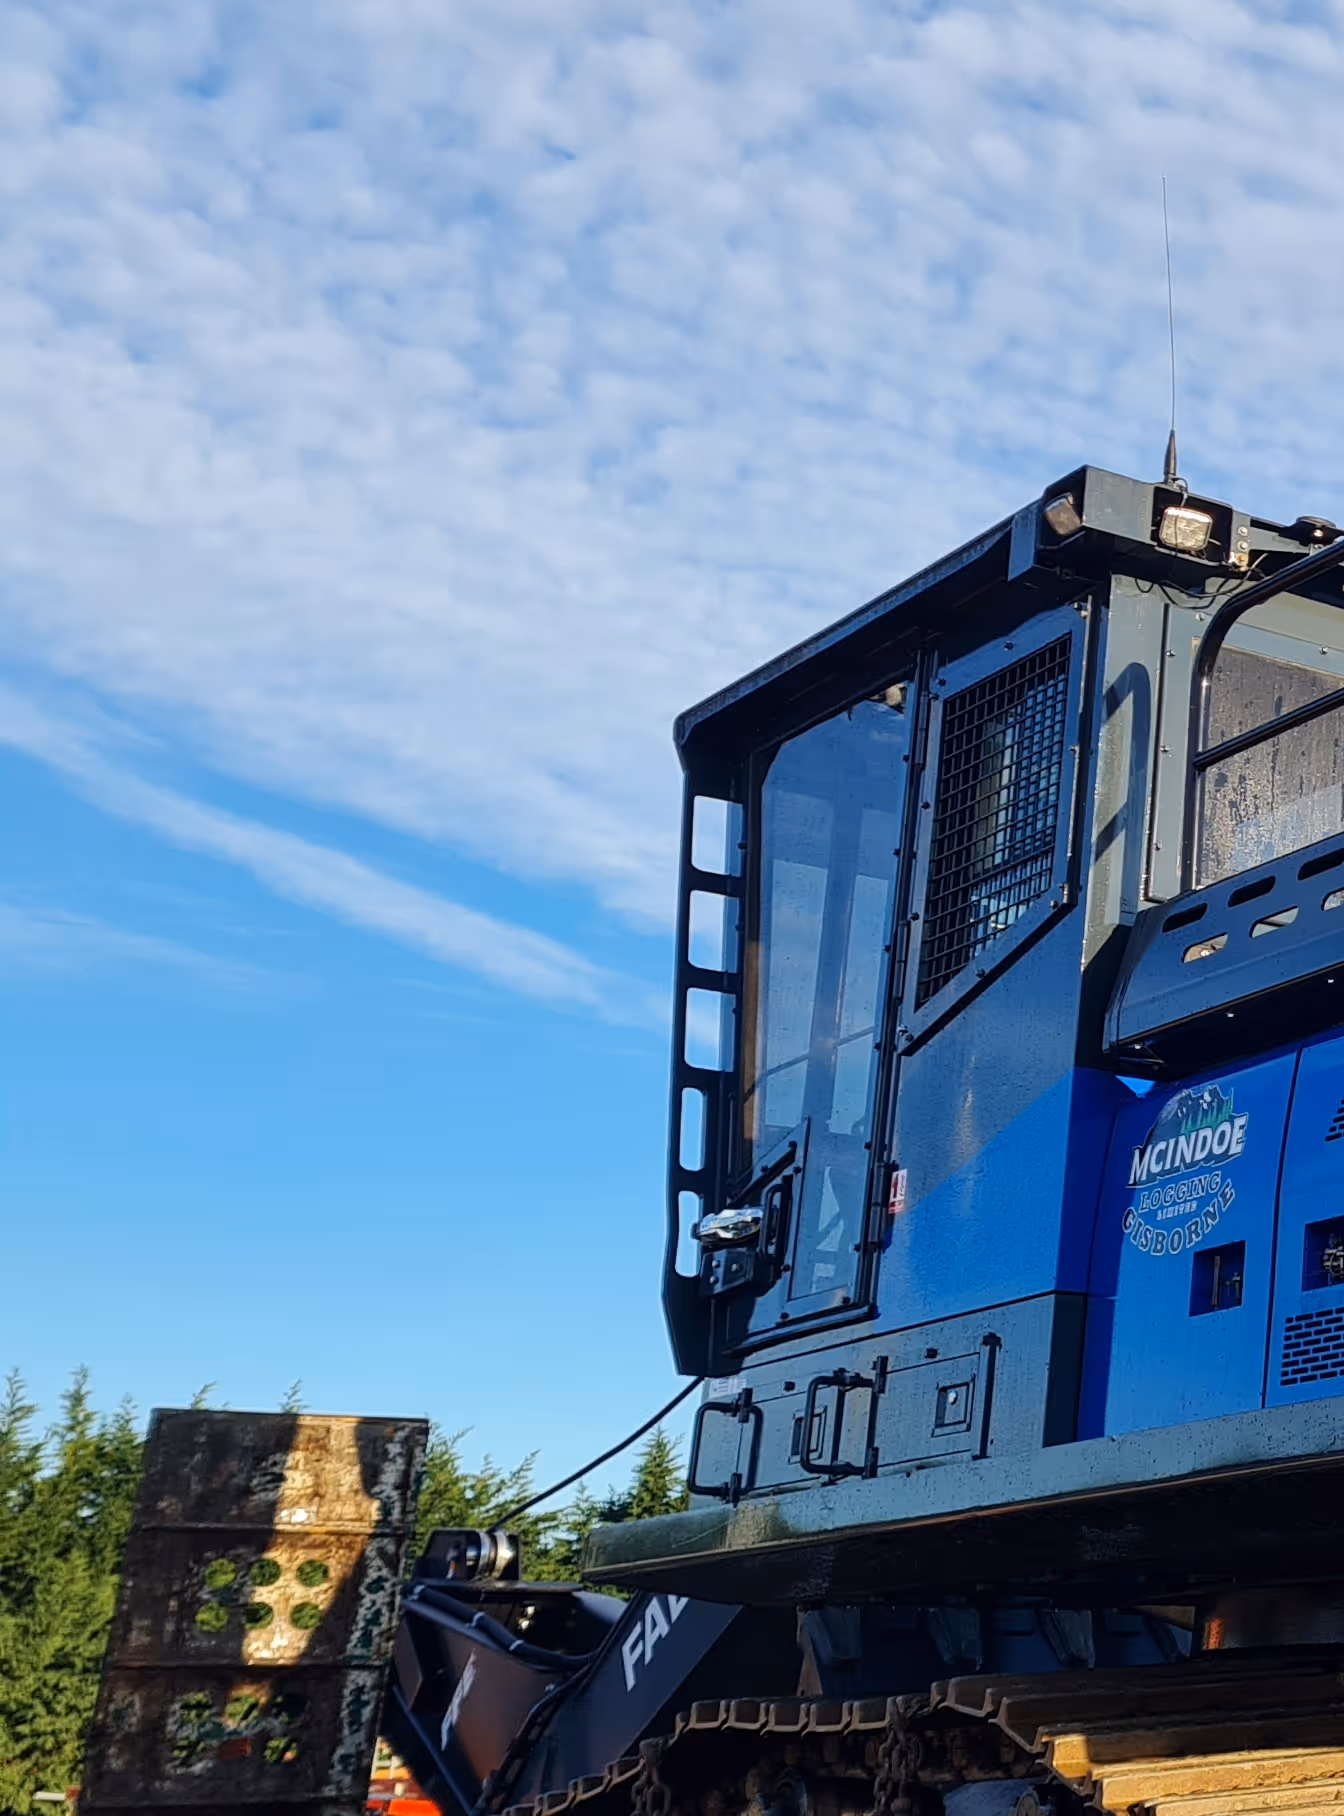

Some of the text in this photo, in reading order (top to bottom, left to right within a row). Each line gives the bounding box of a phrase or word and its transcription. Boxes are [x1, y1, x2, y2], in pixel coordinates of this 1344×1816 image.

[1128, 1115, 1248, 1185] MCINDOE
[1122, 1178, 1235, 1255] GISBORNE
[1138, 1171, 1221, 1213] LOGGING
